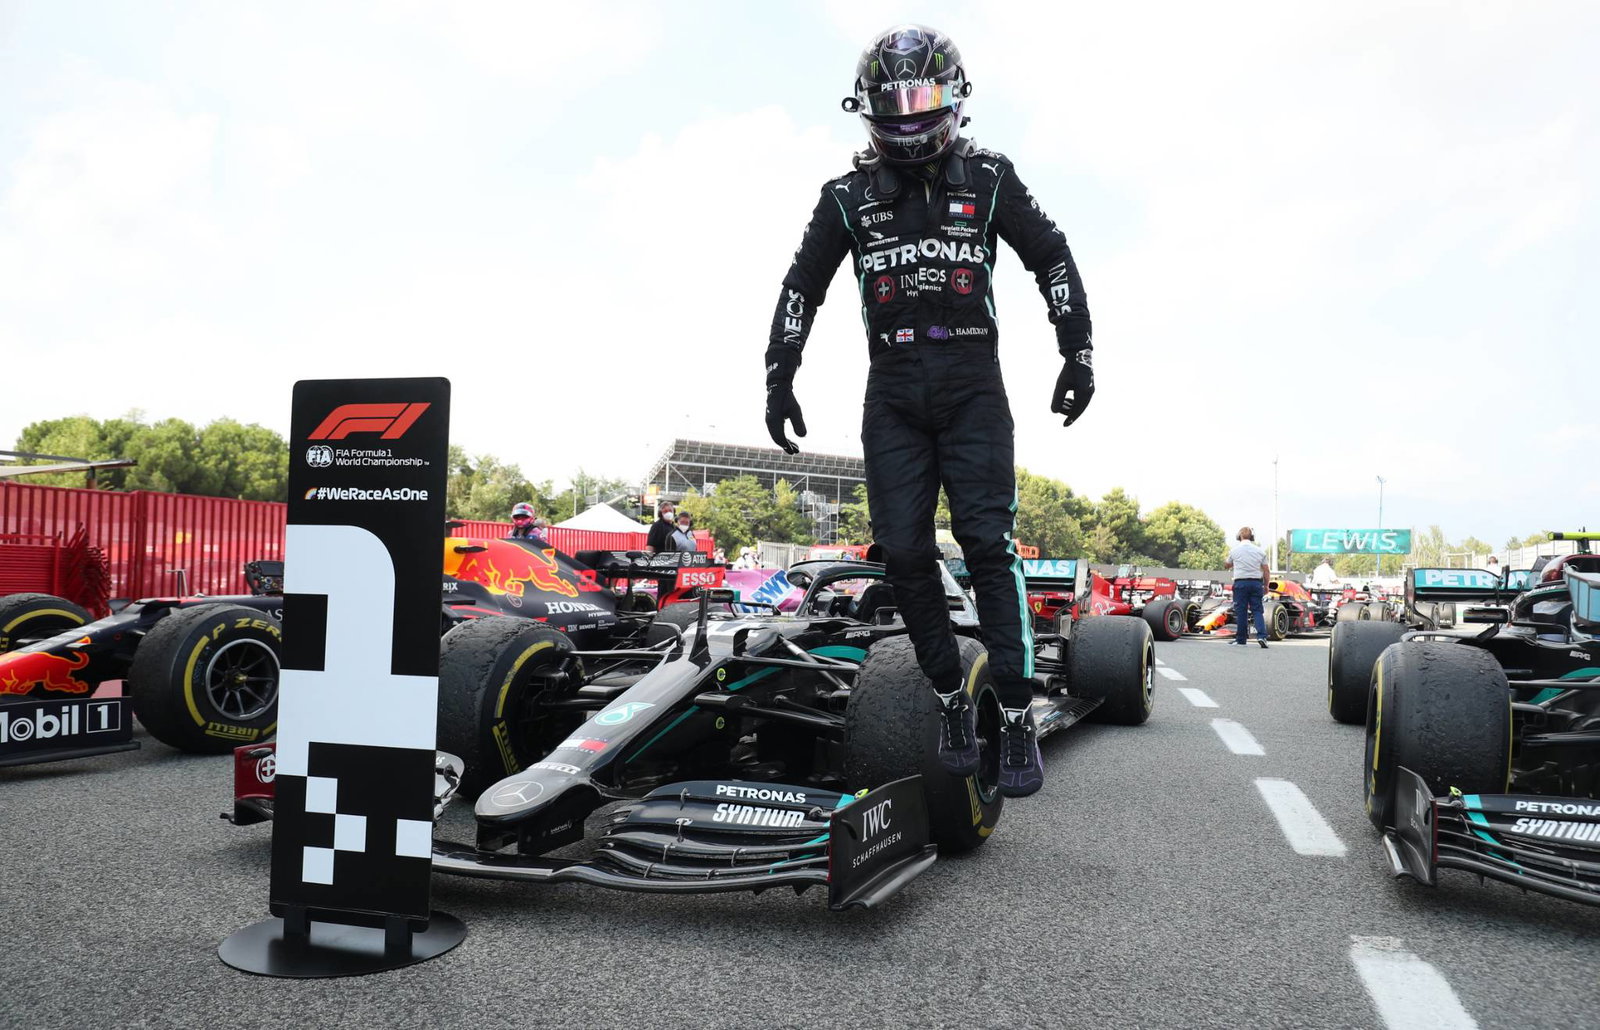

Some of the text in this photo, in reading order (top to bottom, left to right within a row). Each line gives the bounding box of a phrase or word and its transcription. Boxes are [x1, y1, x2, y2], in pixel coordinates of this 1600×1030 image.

[881, 77, 936, 92] PETRONAS
[871, 210, 894, 224] UBS
[862, 238, 985, 274] PETRONAS
[900, 267, 947, 289] INEOS
[336, 449, 350, 457] FIA
[351, 449, 387, 457] Formula
[336, 458, 360, 466] World
[362, 457, 423, 467] Championship
[317, 487, 428, 500] #WeRaceAsOne
[1305, 531, 1398, 550] LEWIS
[682, 572, 716, 586] ESSO
[544, 601, 605, 615] HONDA
[234, 617, 282, 643] ZER
[0, 704, 80, 744] obil
[715, 784, 806, 804] PETRONAS
[712, 803, 806, 828] SYNTIUM
[862, 798, 892, 843] IWC
[852, 831, 902, 869] SCHAFFHAUSEN
